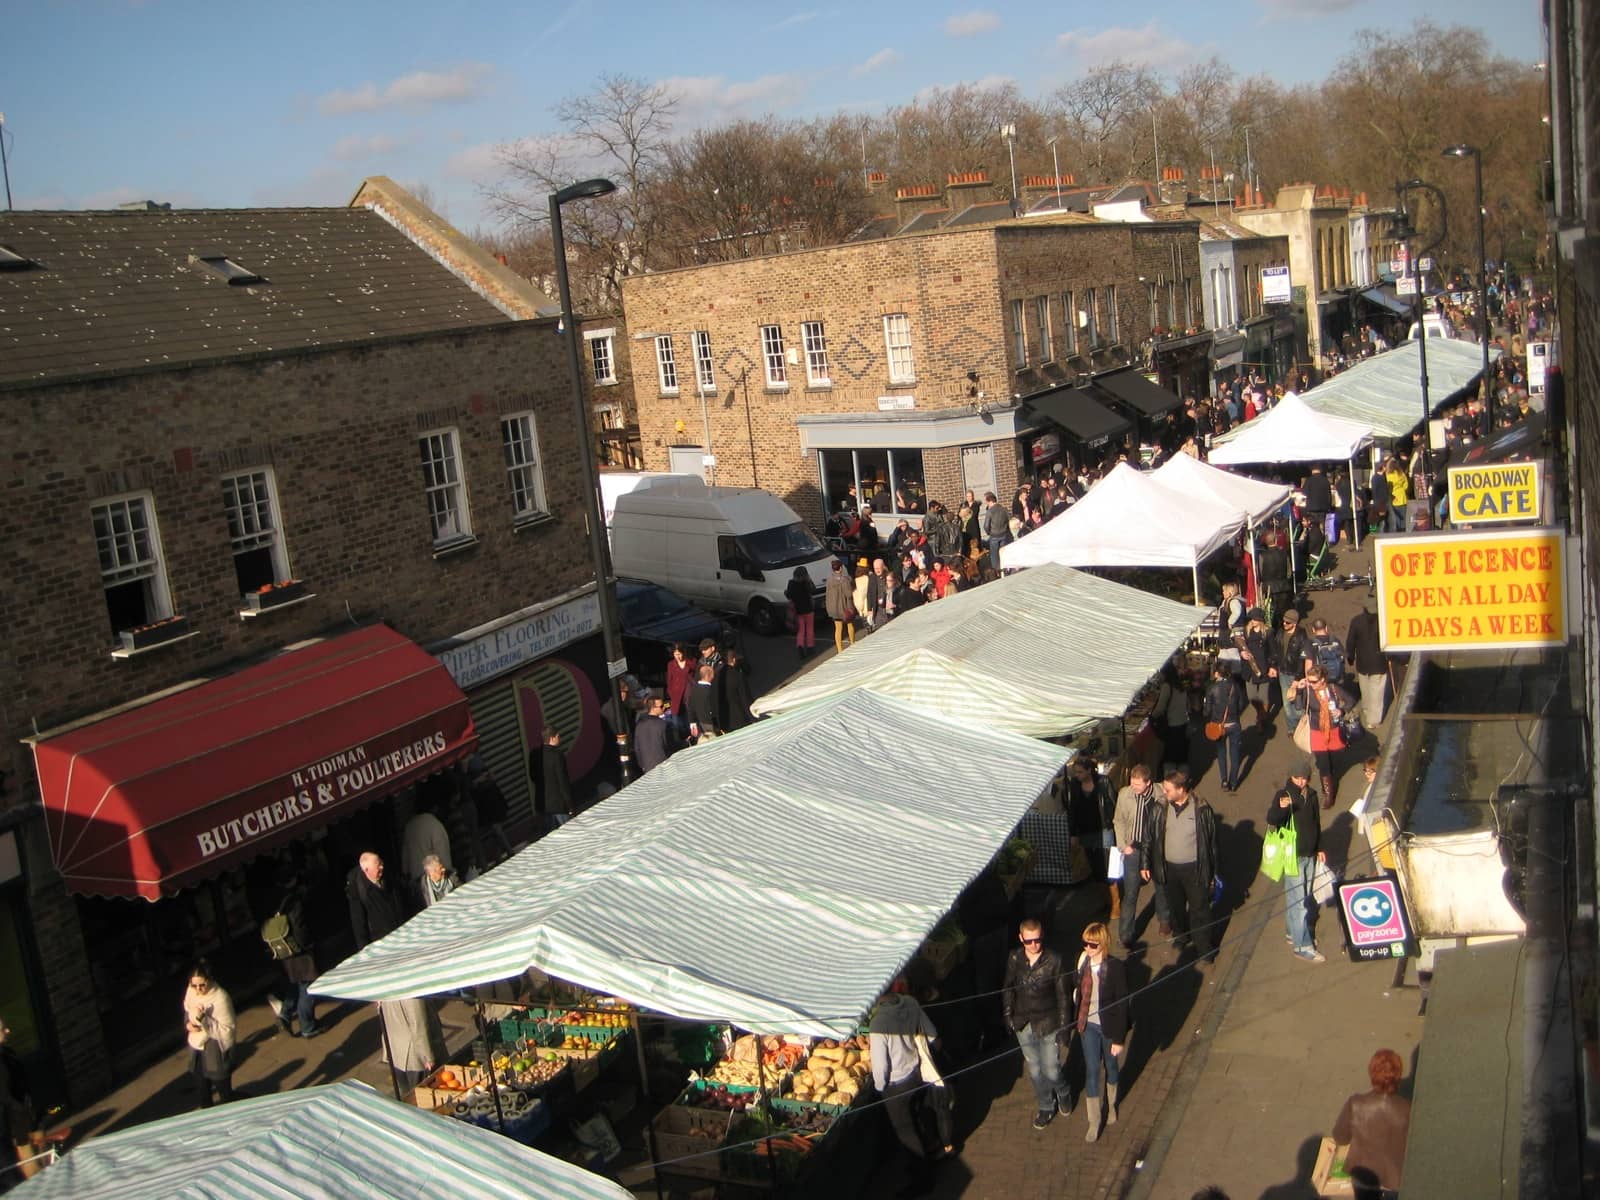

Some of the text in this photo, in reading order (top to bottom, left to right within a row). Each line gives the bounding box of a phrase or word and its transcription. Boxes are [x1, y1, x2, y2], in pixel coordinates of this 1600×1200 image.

[1455, 468, 1530, 490] BROADWAY
[1457, 489, 1532, 516] CAFE
[1390, 546, 1553, 577] OFF LICENCE
[1394, 583, 1552, 608] OPEN ALL DAY
[495, 612, 570, 653] FLOORING
[1393, 614, 1555, 638] 7 DAYS A WEEK
[197, 731, 447, 857] BUTCHERS & POULTERERS
[1357, 927, 1399, 942] payzone
[1360, 947, 1389, 958] top-up
